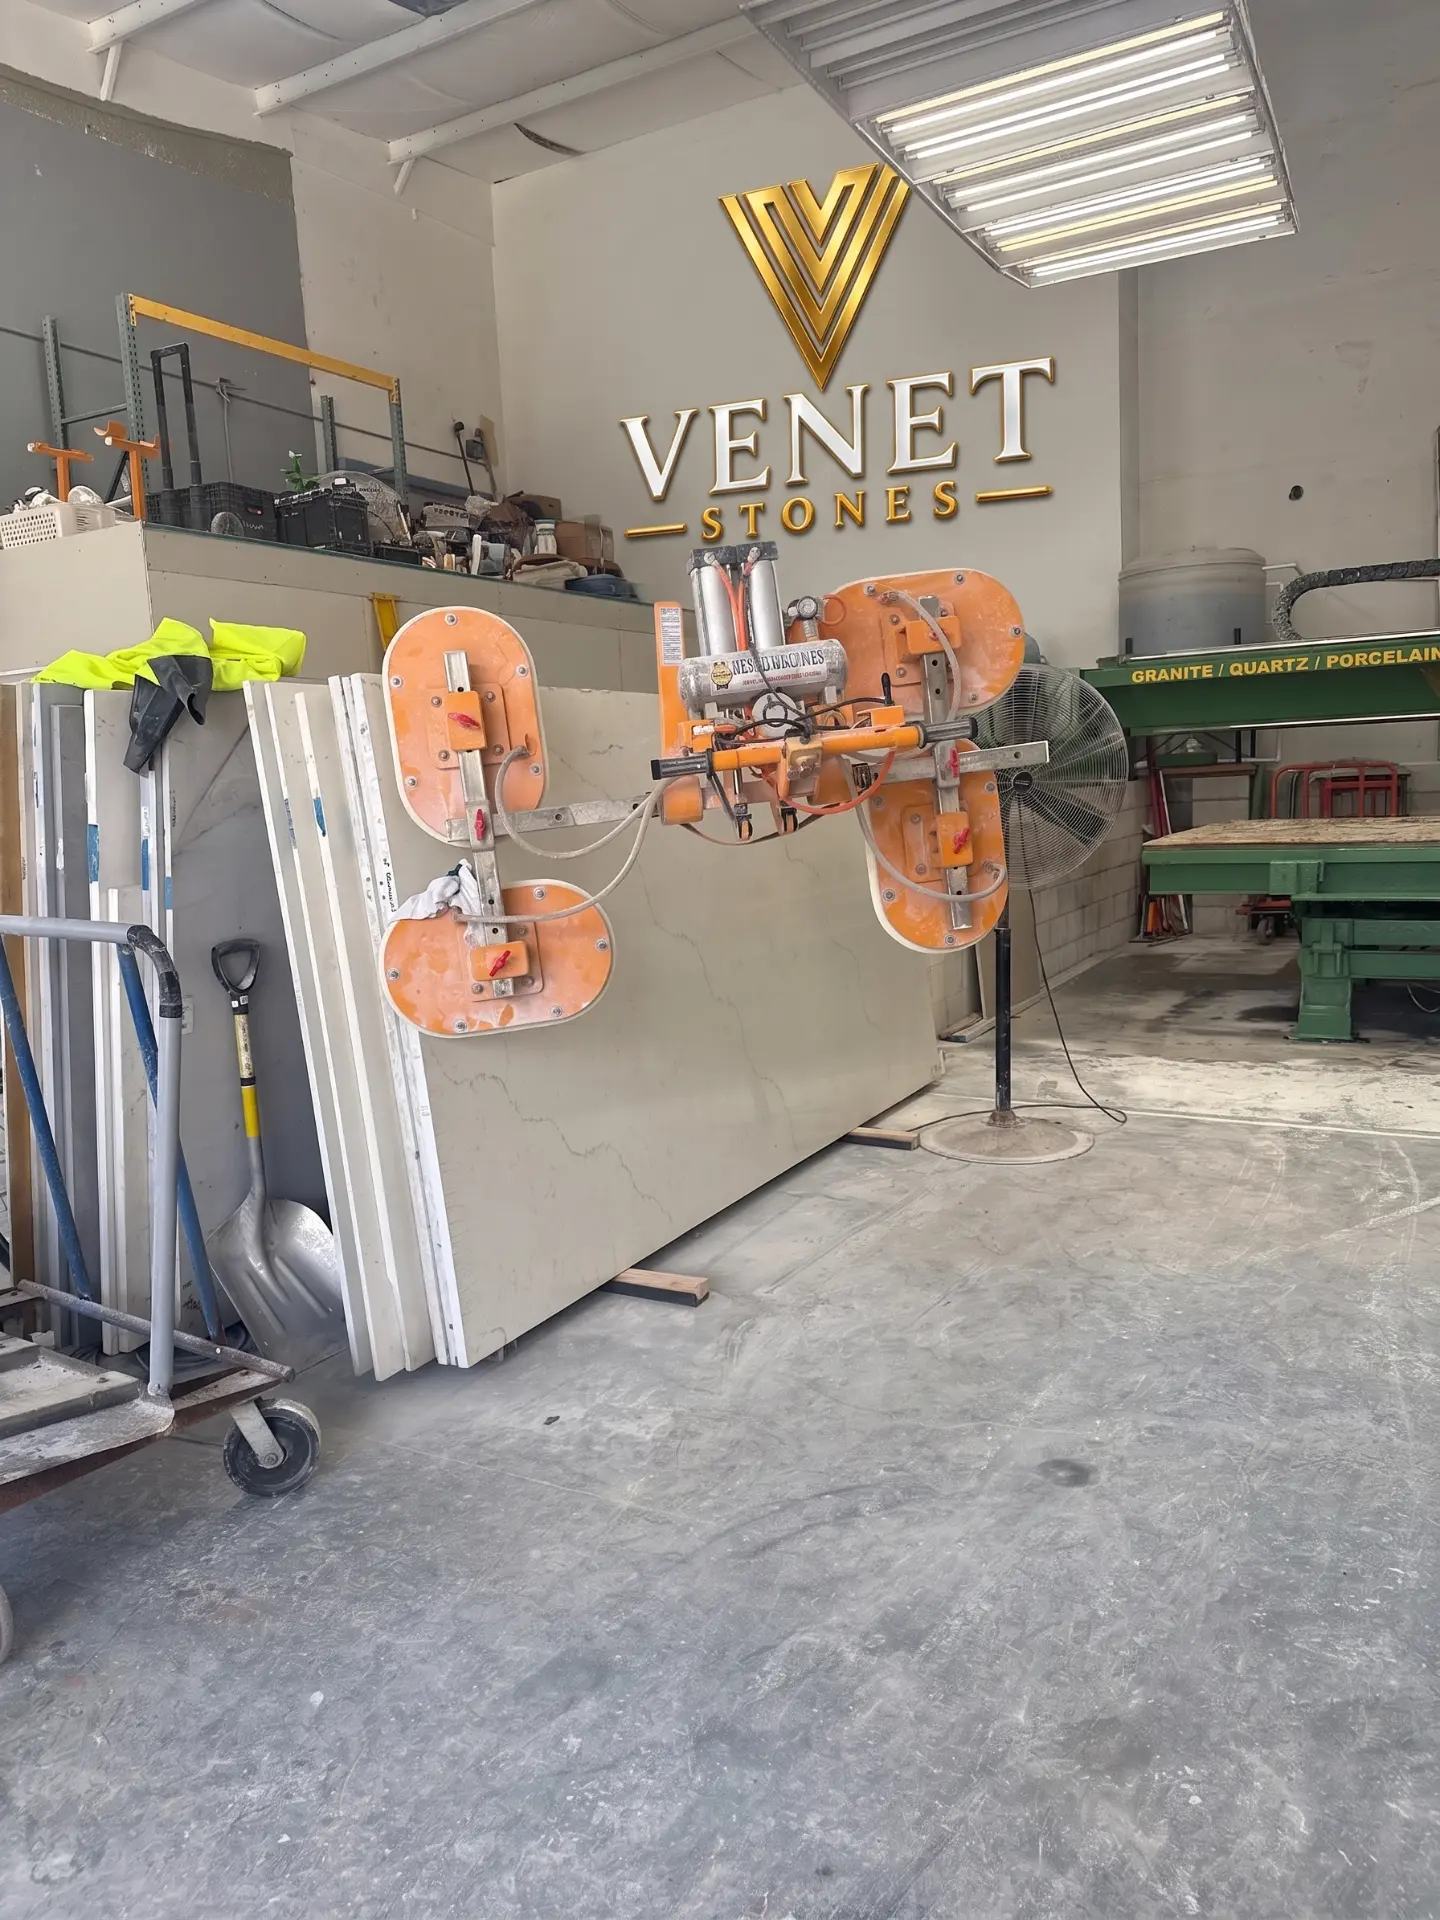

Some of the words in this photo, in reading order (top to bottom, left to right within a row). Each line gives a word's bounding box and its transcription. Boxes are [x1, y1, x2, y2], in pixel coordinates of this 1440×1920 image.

[620, 356, 1054, 501] VENET
[701, 480, 958, 542] STONES
[1132, 664, 1213, 684] GRANITE
[1229, 656, 1309, 676] QUARTZ
